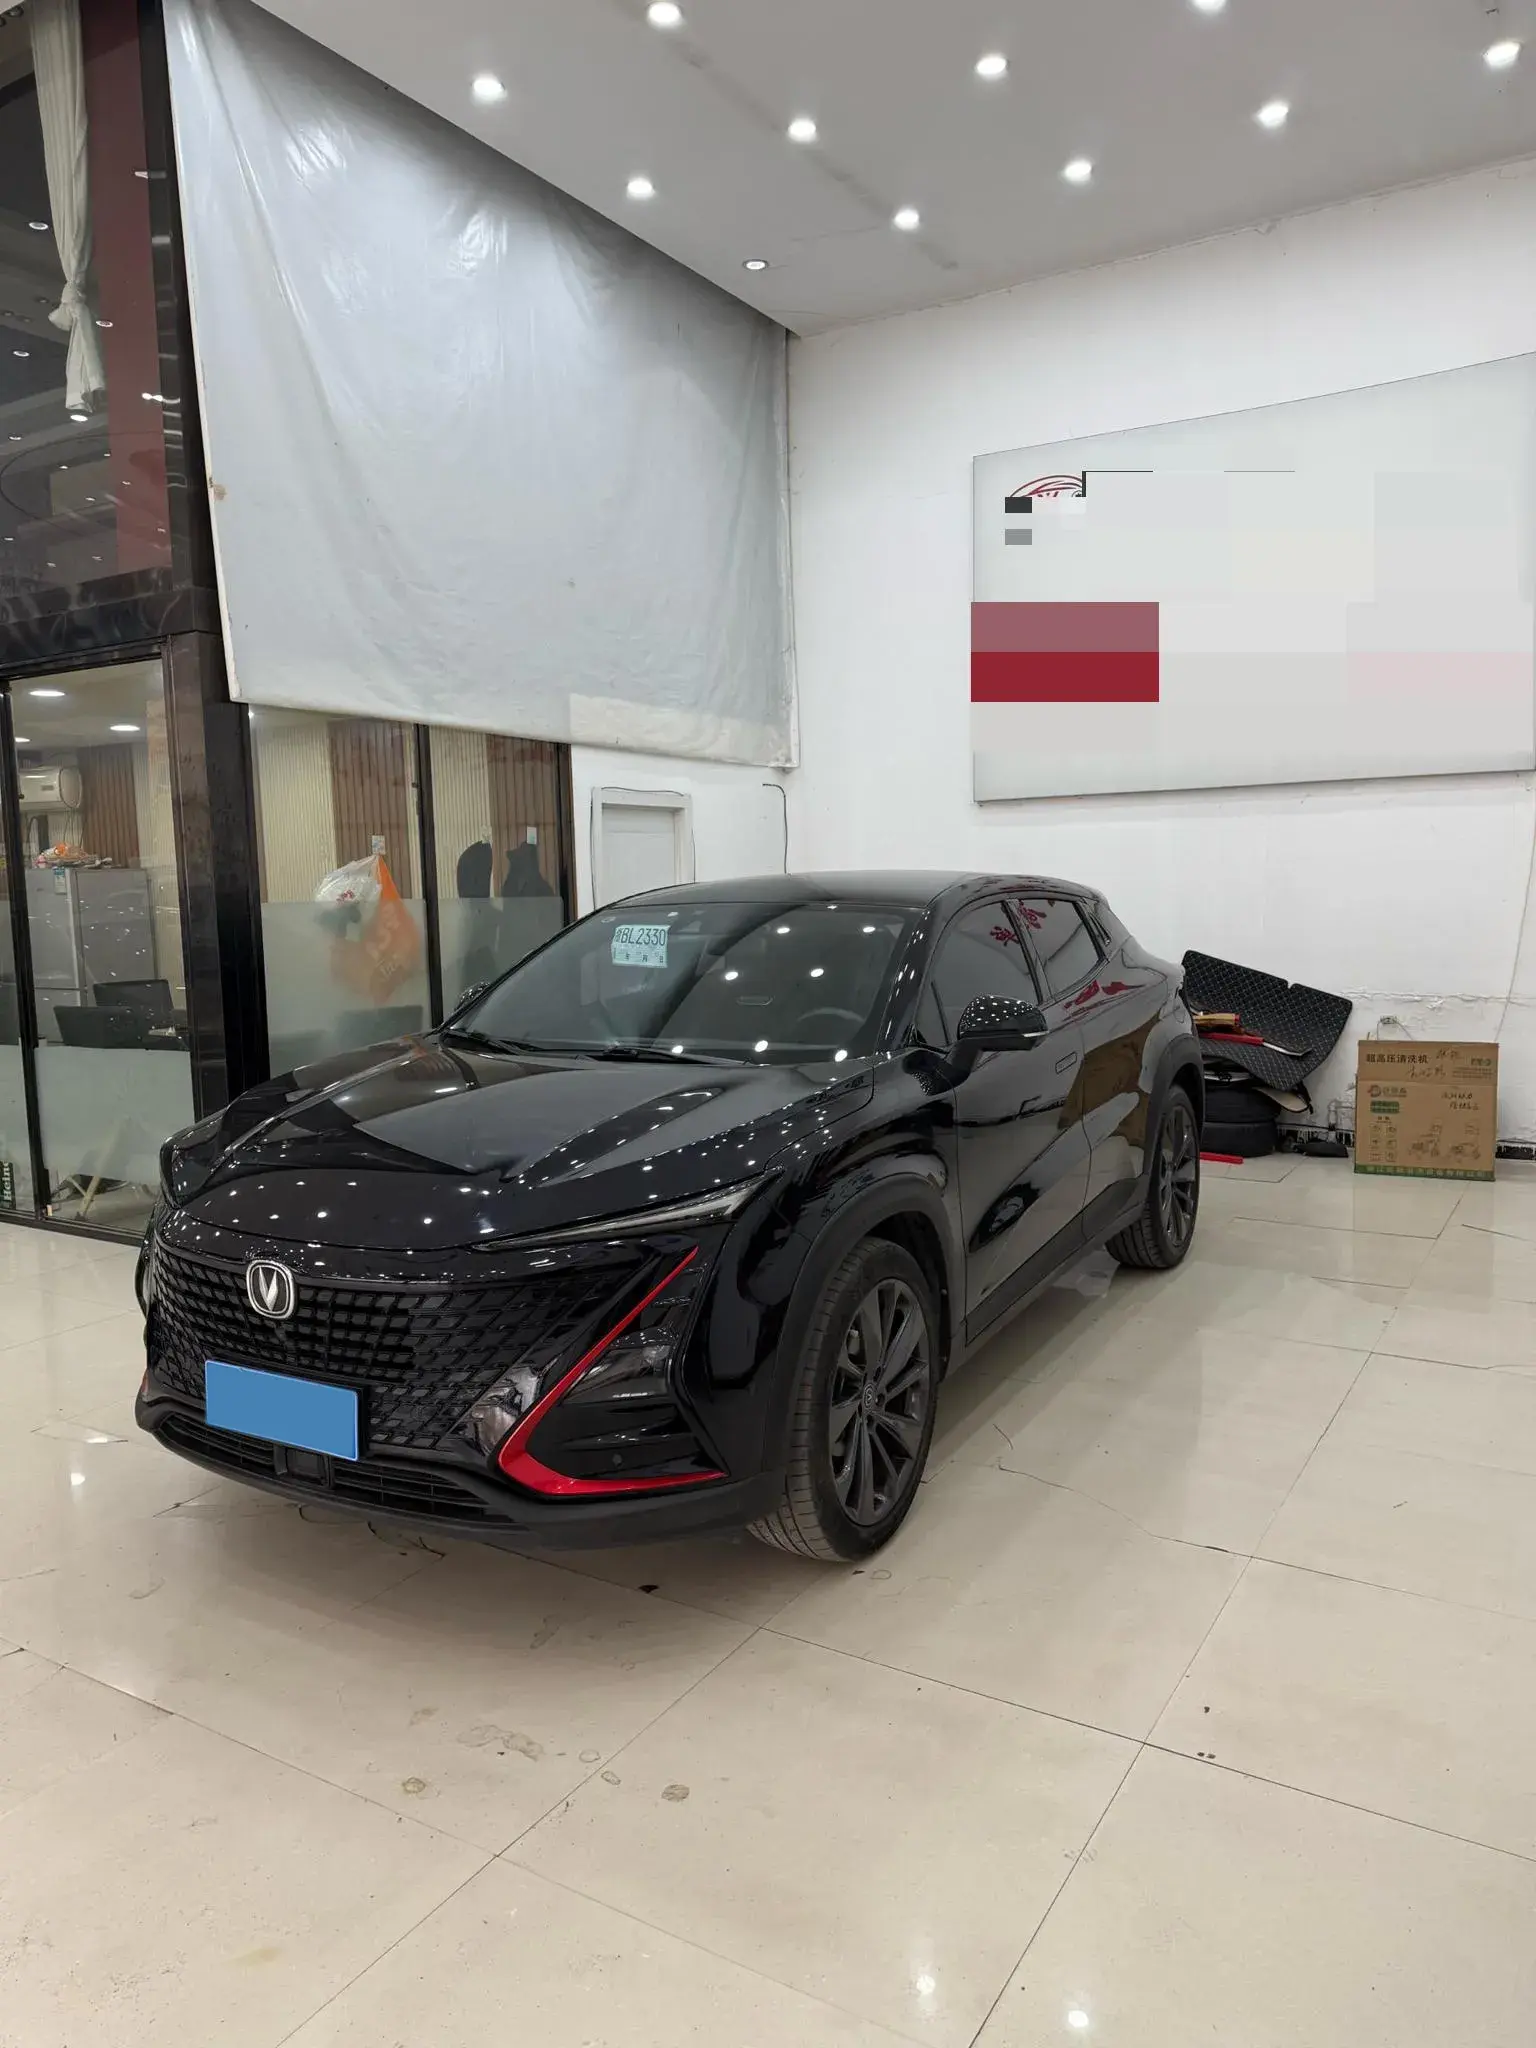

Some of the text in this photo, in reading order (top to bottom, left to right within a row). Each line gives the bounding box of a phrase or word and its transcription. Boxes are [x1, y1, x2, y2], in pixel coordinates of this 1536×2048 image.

[1366, 1053, 1428, 1064] 超高压清洗机
